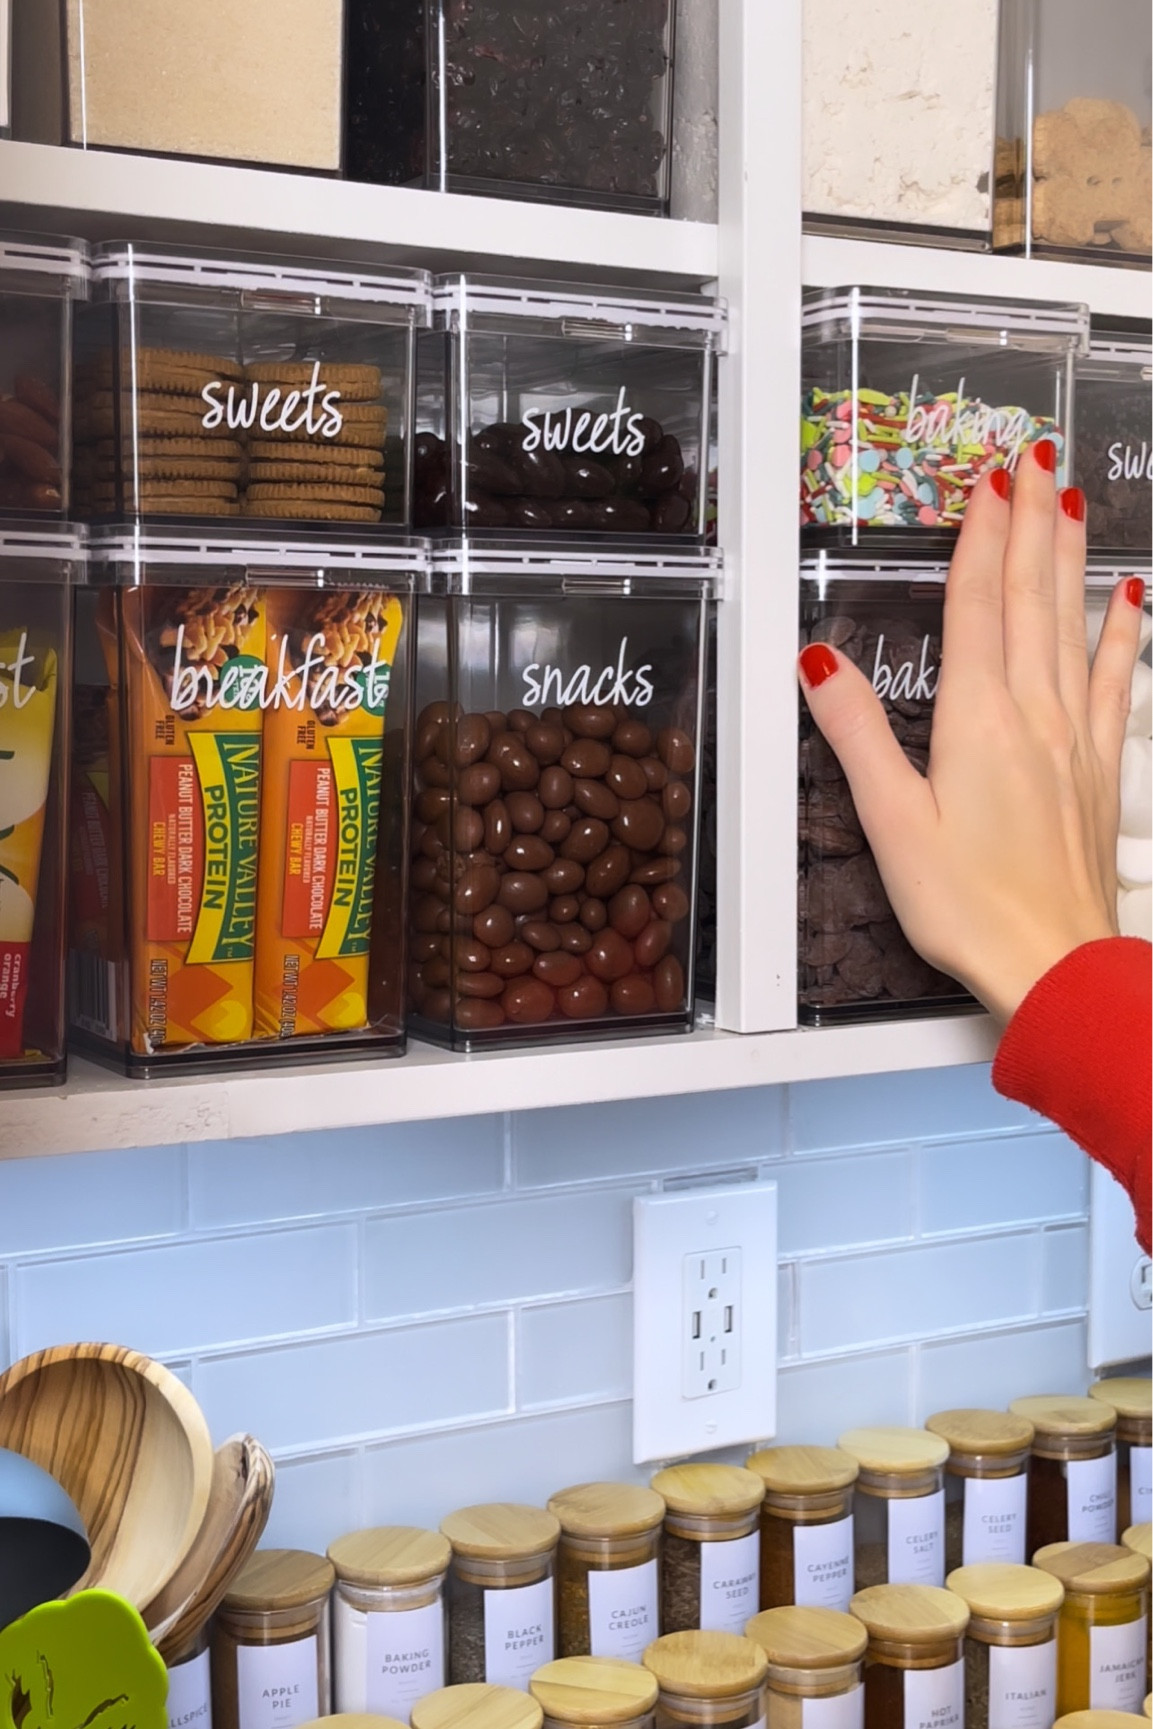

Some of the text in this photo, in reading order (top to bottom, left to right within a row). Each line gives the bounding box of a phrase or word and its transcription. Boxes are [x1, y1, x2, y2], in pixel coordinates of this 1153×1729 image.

[200, 360, 343, 438] sweets
[522, 385, 646, 457] sweets
[904, 373, 1031, 473] baking
[170, 623, 388, 711] breakfast
[521, 635, 655, 708] snacks
[872, 633, 942, 700] bak
[155, 720, 165, 740] FREE
[165, 714, 175, 746] GLUTEN
[297, 725, 306, 745] FREE
[306, 720, 316, 750] GLUTEN
[152, 821, 166, 877] CHEWY BAR
[177, 763, 194, 934] PEANUT BUTTER DARK CHOCOLATE
[203, 784, 228, 910] PROTEIN
[221, 742, 260, 946] NATURE VALLEY
[289, 822, 304, 876] CHEWY BAR
[309, 767, 331, 931] PEANUT BUTTER DARK CHOCOLATE
[333, 786, 360, 908] PROTEIN
[5, 953, 22, 1018] cranberry
[981, 1513, 1017, 1524] CELERY
[905, 1531, 938, 1545] CELERY
[988, 1524, 1012, 1534] SEED
[913, 1542, 934, 1554] SALT
[807, 1555, 850, 1573] CAYENNE
[812, 1568, 847, 1583] PEPPER
[725, 1587, 750, 1600] SEED
[611, 1605, 646, 1619] CAJUN
[507, 1624, 542, 1639] BLACK
[608, 1614, 649, 1631] CREOLE
[504, 1635, 544, 1650] PEPPER
[385, 1649, 430, 1663] BAKING
[382, 1660, 432, 1675] POWDER
[1114, 1671, 1136, 1684] JERK
[262, 1684, 300, 1698] APPLE
[1004, 1689, 1048, 1701] ITALIAN
[272, 1698, 292, 1709] PIE
[931, 1705, 952, 1719] HOT
[169, 1702, 209, 1728] LLSPICE
